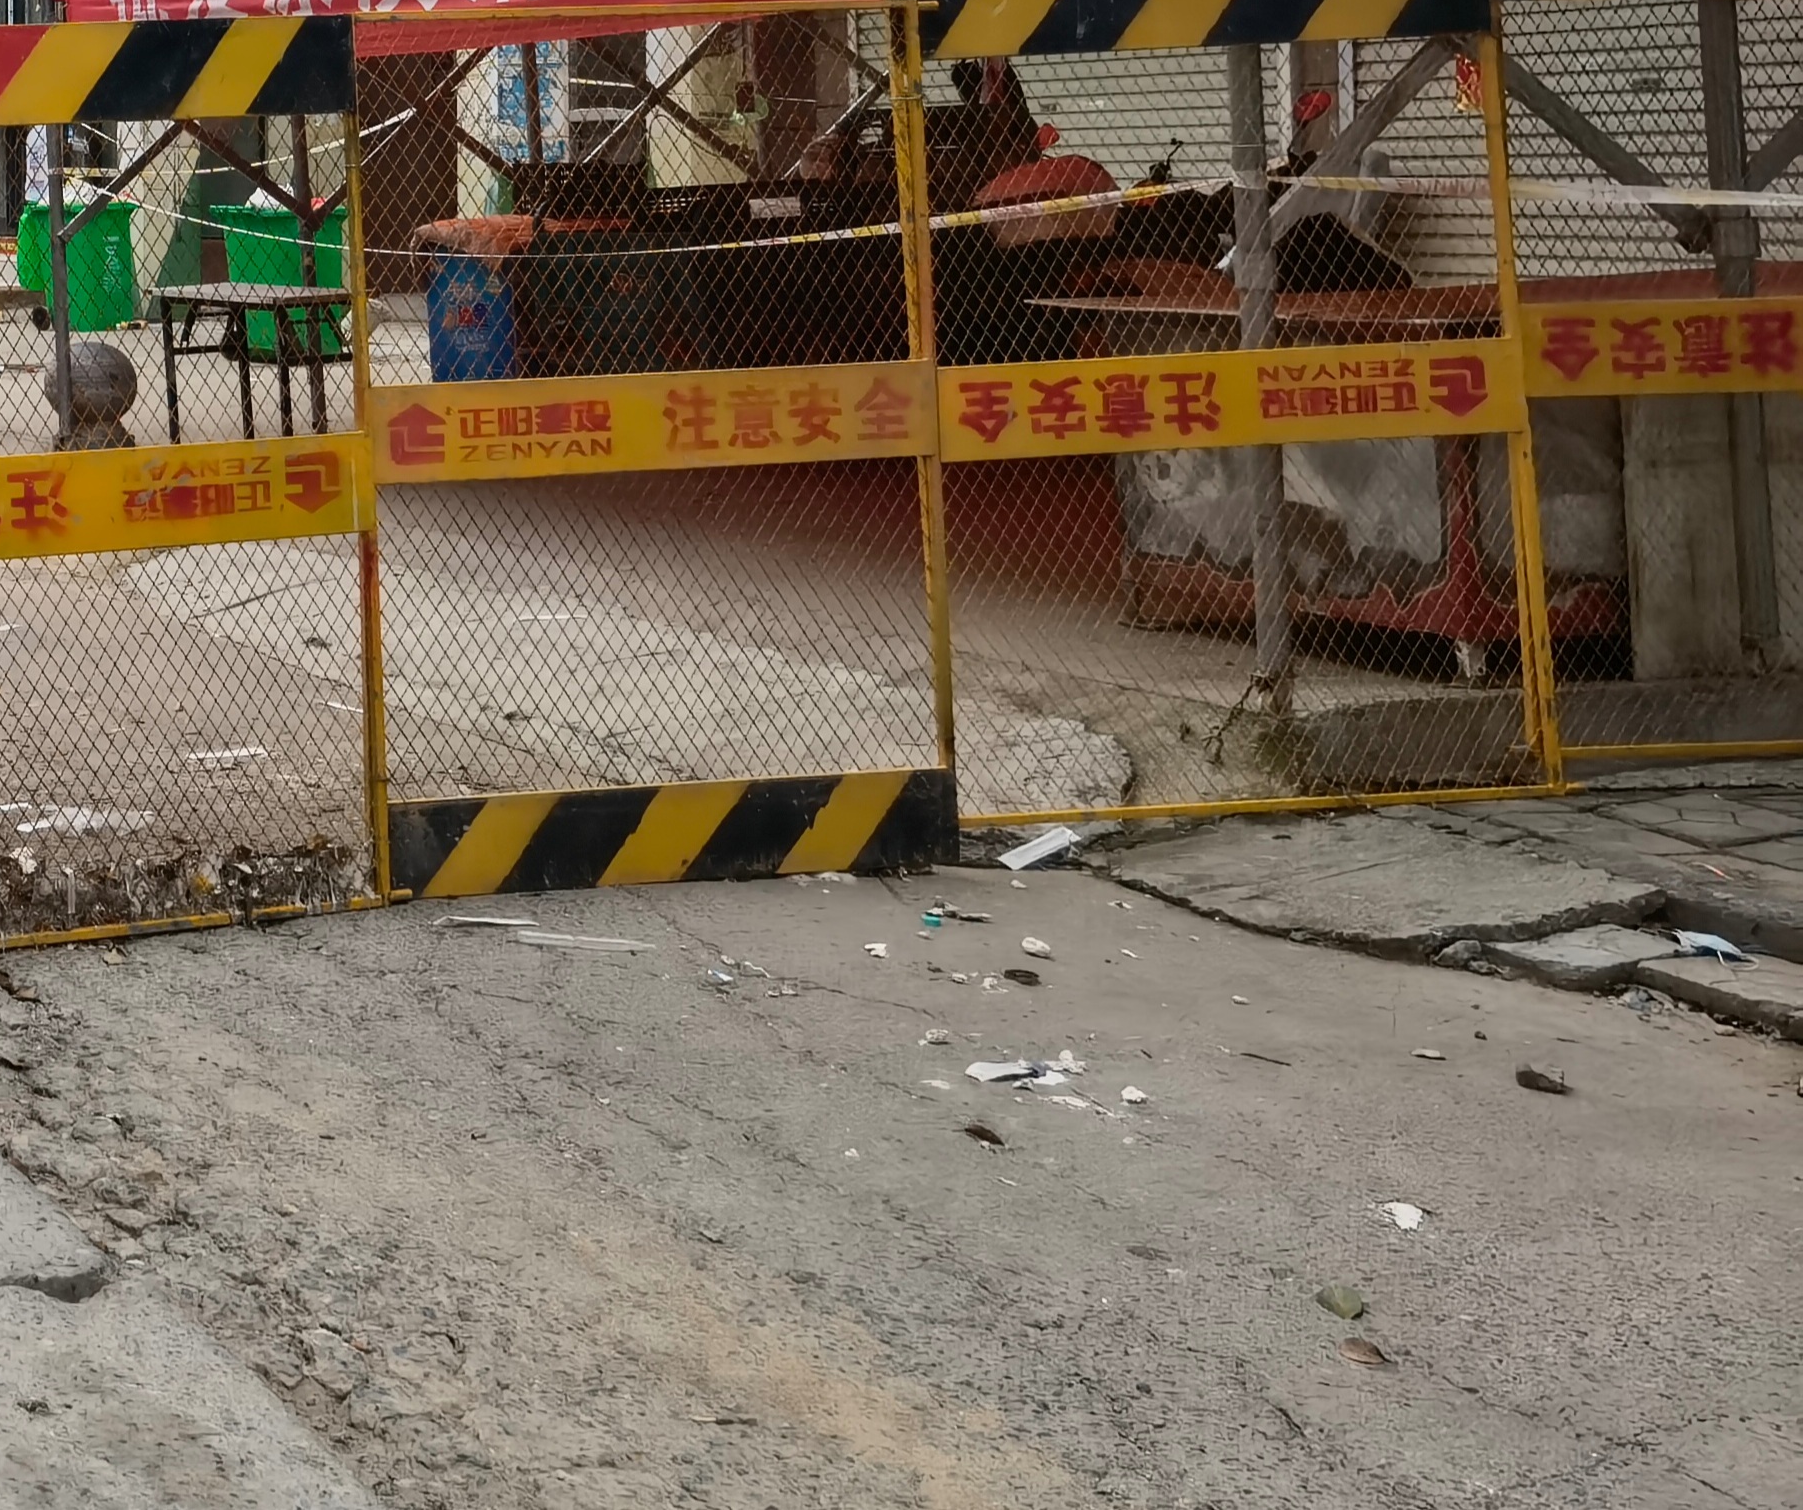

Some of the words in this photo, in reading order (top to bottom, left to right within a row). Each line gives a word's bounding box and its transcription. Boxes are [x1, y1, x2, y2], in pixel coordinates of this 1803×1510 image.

[1256, 359, 1417, 385] ZENYAN
[1539, 308, 1797, 382] 注意安全
[661, 376, 914, 451] 注意安全
[958, 369, 1221, 444] 注意安全
[458, 437, 613, 464] ZENYAN
